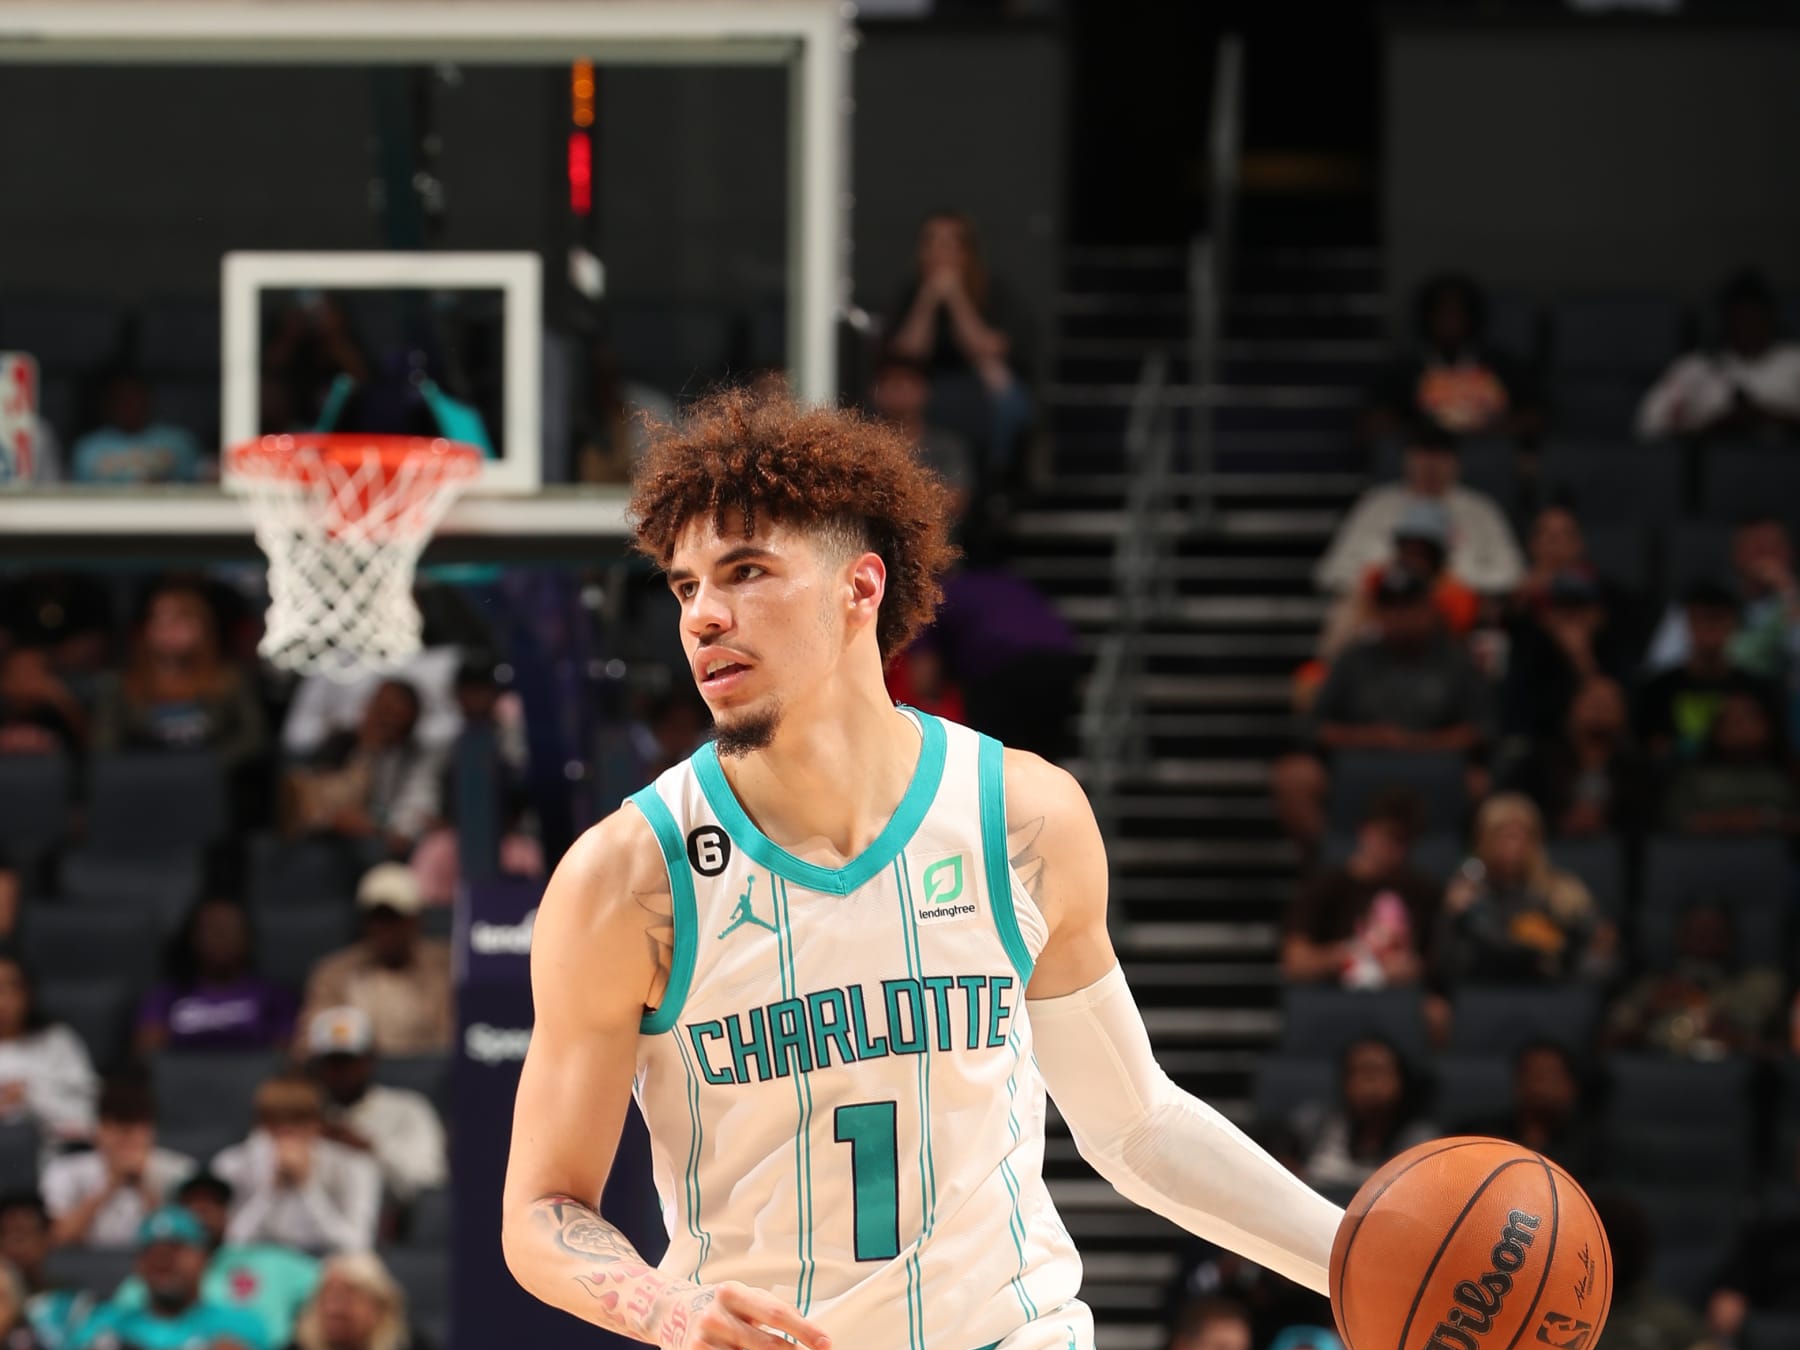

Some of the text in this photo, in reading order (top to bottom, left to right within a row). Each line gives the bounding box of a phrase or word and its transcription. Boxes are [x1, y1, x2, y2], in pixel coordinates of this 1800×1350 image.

[695, 832, 723, 870] 6
[918, 904, 976, 920] lendingtree
[685, 975, 1014, 1086] CHARLOTTE
[833, 1100, 900, 1262] 1
